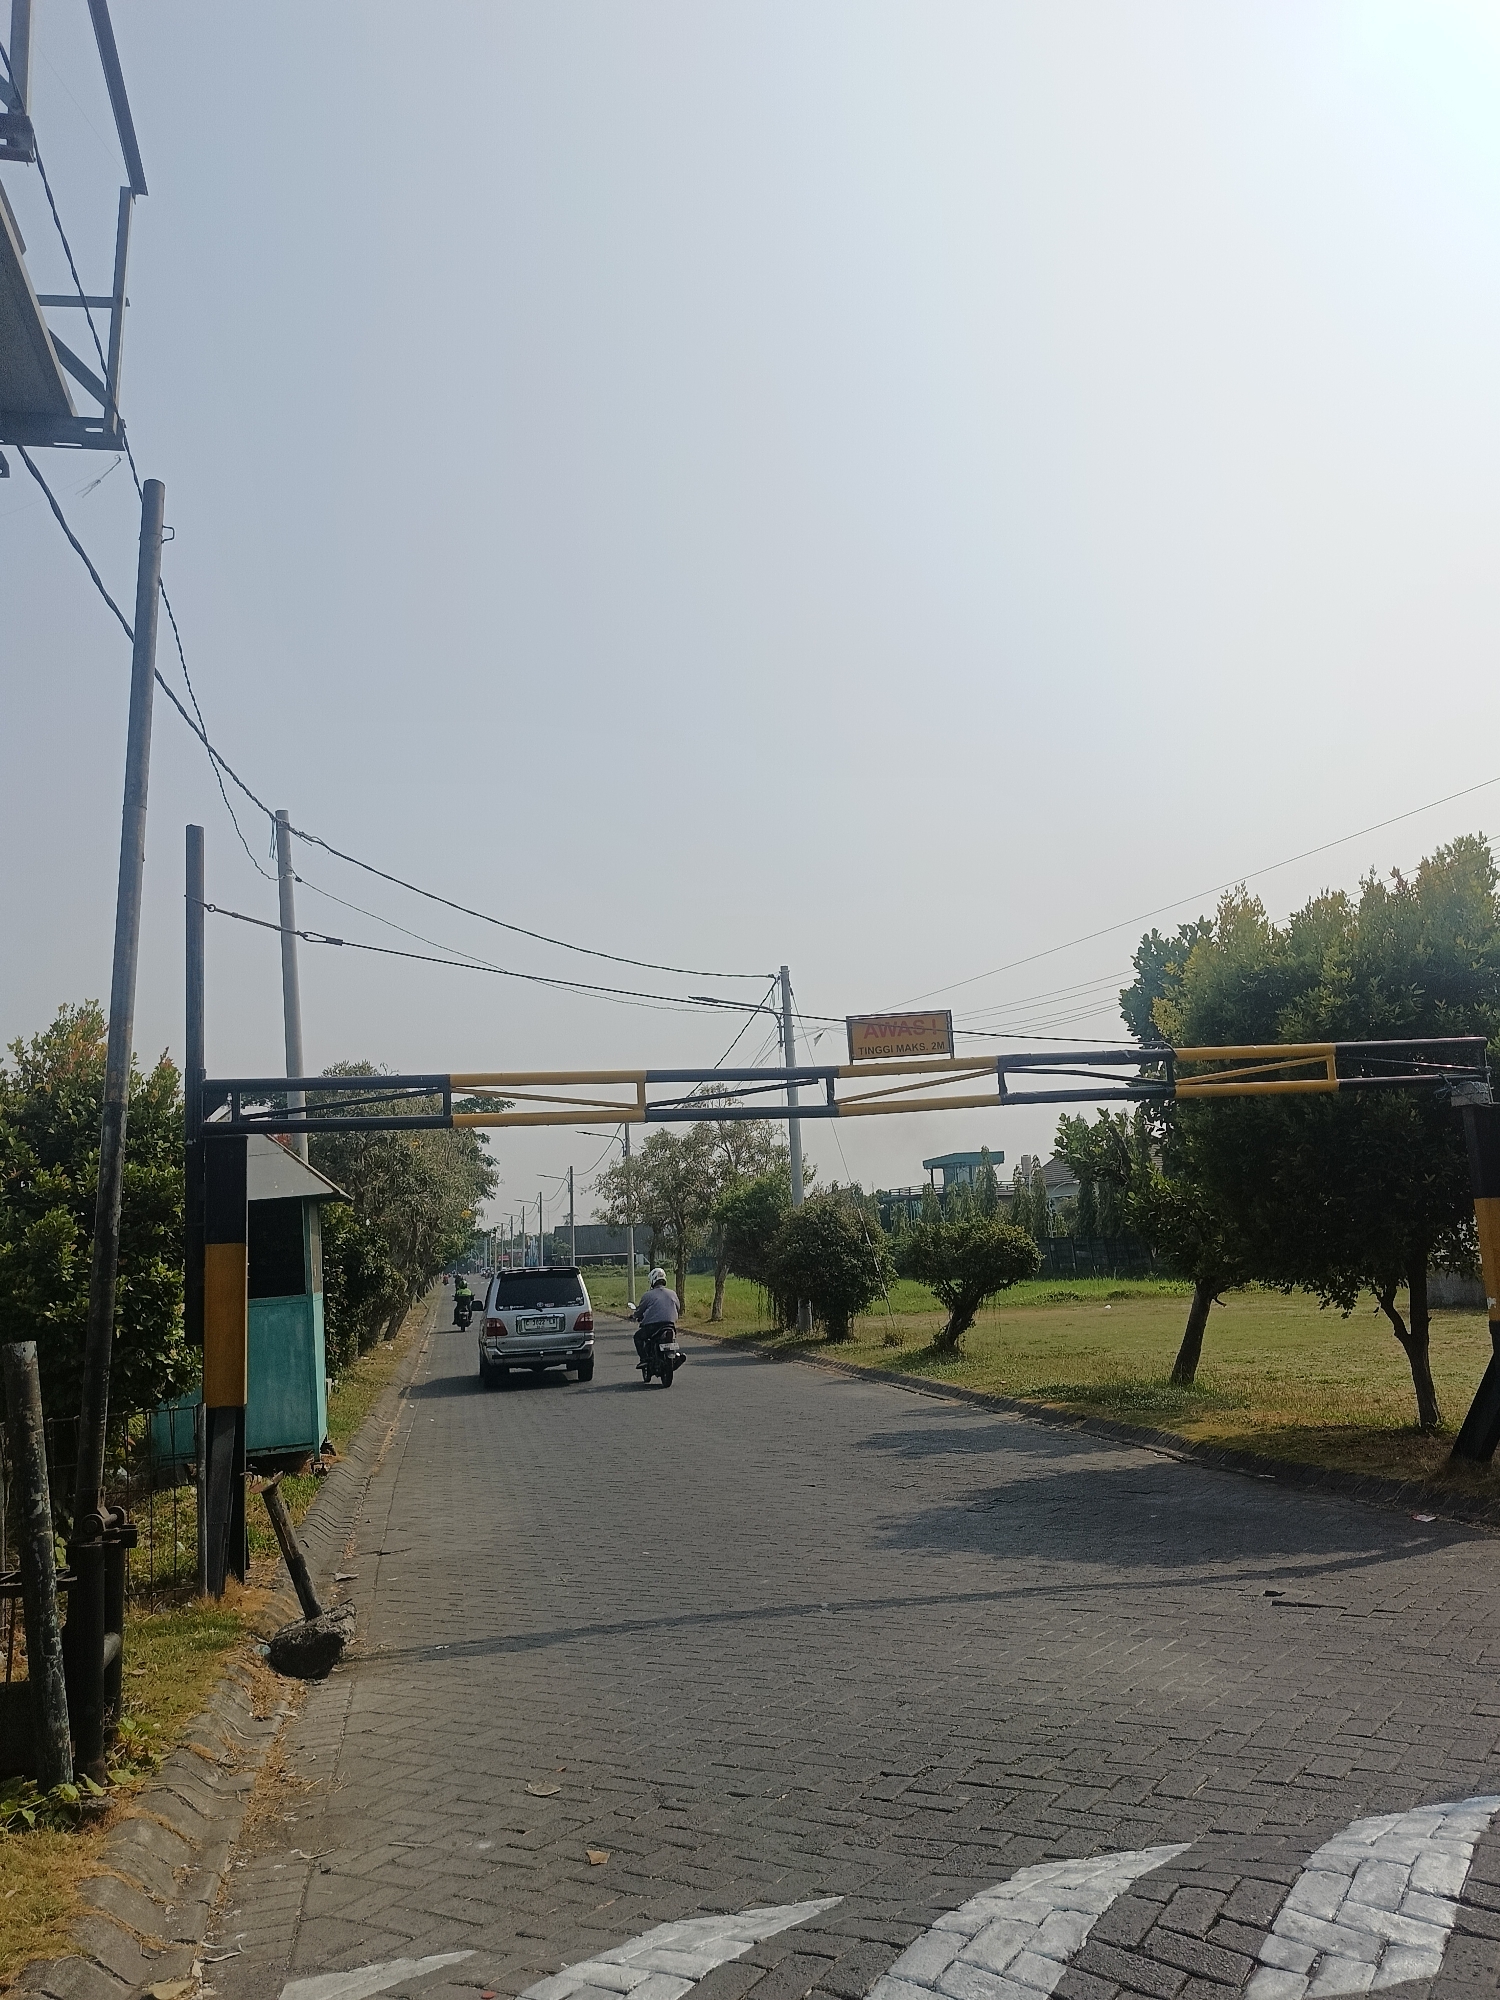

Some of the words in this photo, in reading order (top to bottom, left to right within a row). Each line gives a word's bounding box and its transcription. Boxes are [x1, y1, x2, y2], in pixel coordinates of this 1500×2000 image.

[858, 1045, 894, 1056] TINGGI
[896, 1042, 929, 1053] MAKS.
[931, 1041, 945, 1050] 2M
